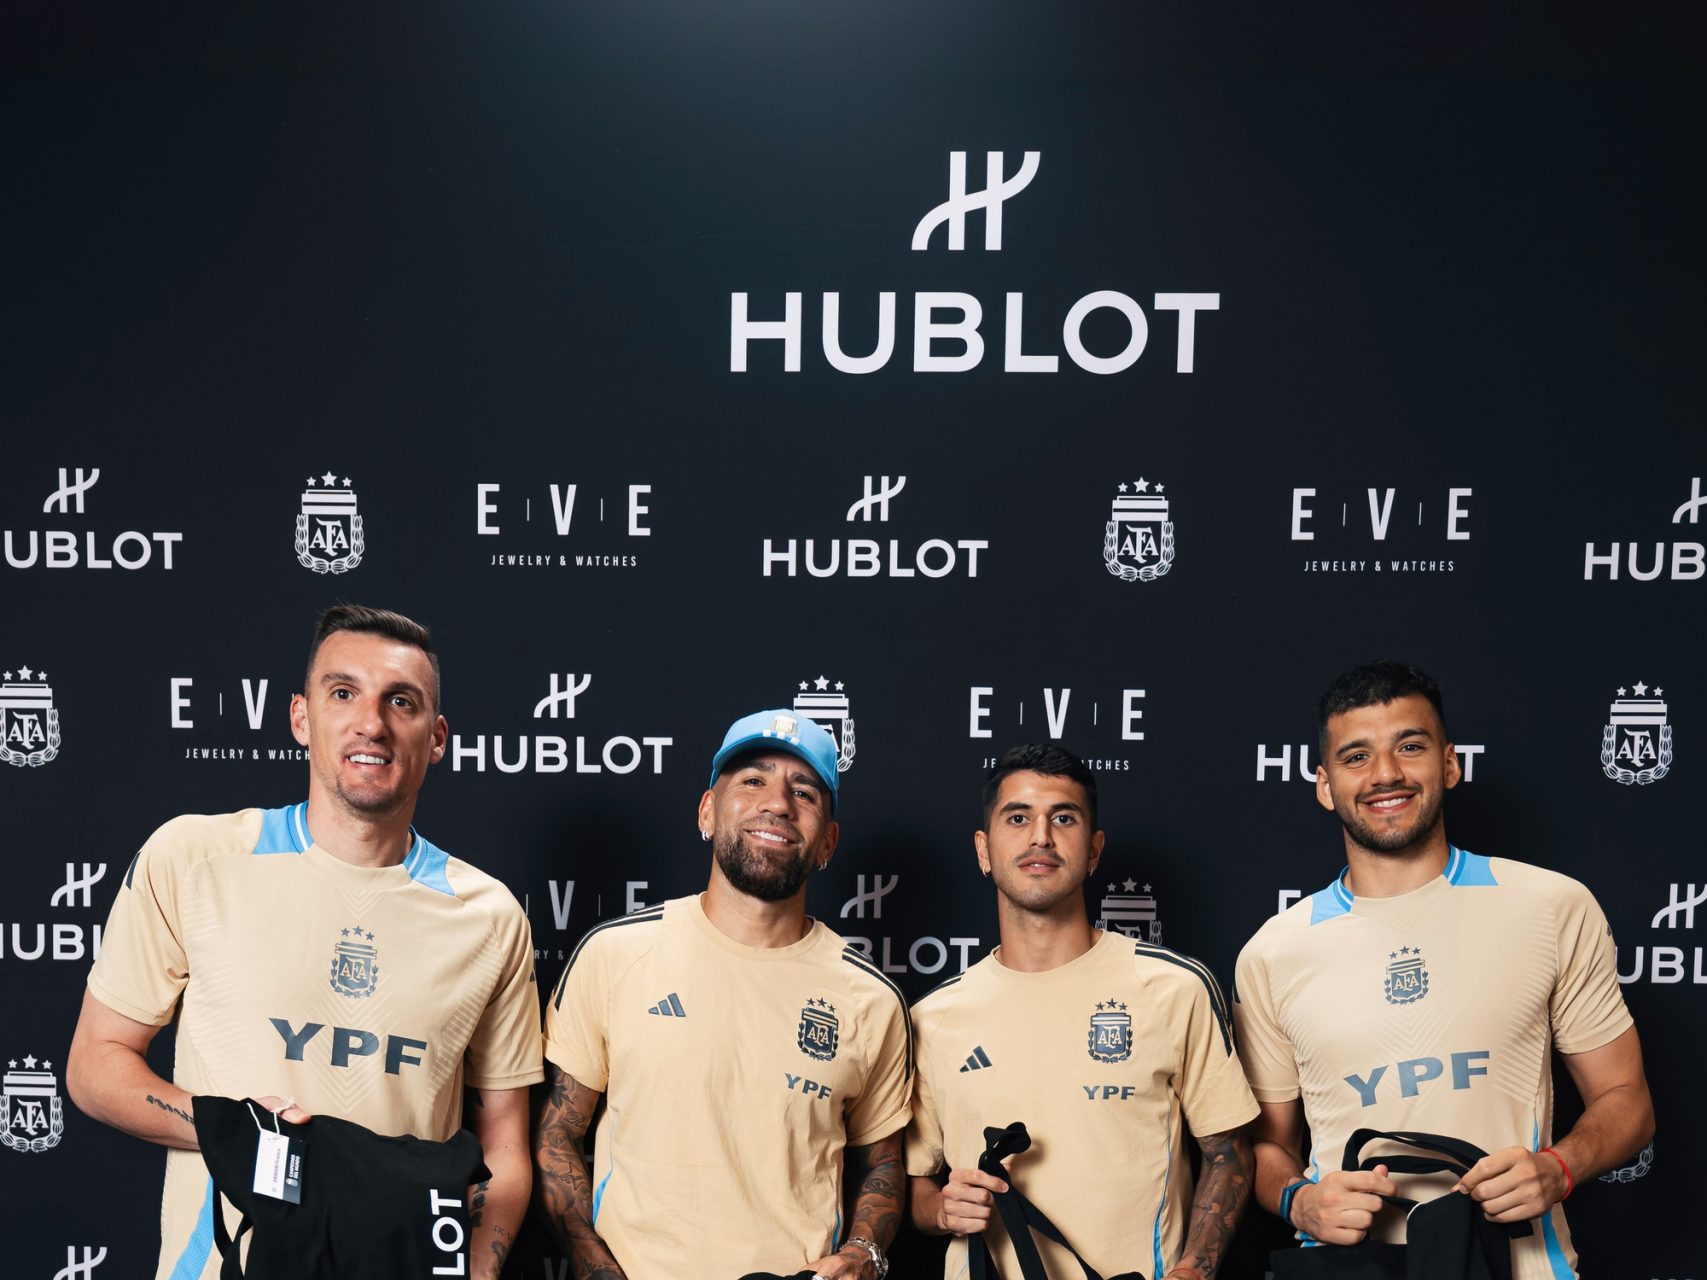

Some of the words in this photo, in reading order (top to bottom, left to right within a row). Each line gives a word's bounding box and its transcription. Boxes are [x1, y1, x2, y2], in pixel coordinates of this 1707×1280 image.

[731, 290, 1220, 375] HUBLOT
[4, 530, 183, 570] UBLOT
[311, 519, 346, 557] AFA
[1117, 526, 1159, 565] AFA
[491, 554, 551, 566] JEWELRY
[559, 555, 566, 566] &
[575, 555, 637, 567] WATCHES
[763, 538, 988, 578] HUBLOT
[1304, 560, 1366, 572] JEWELRY
[1374, 560, 1381, 572] &
[1391, 560, 1454, 572] WATCHES
[1584, 542, 1706, 581] HUB
[185, 748, 244, 759] JEWELRY
[252, 749, 259, 760] &
[268, 749, 310, 760] WATCH
[452, 734, 673, 774] HUBLOT
[1082, 759, 1129, 770] TCHES
[1617, 730, 1656, 767] AFA
[268, 1017, 428, 1076] YPF
[784, 1072, 832, 1100] YPF
[1083, 1085, 1136, 1101] YPF
[1343, 1050, 1490, 1108] YPF
[12, 1098, 49, 1137] AFA
